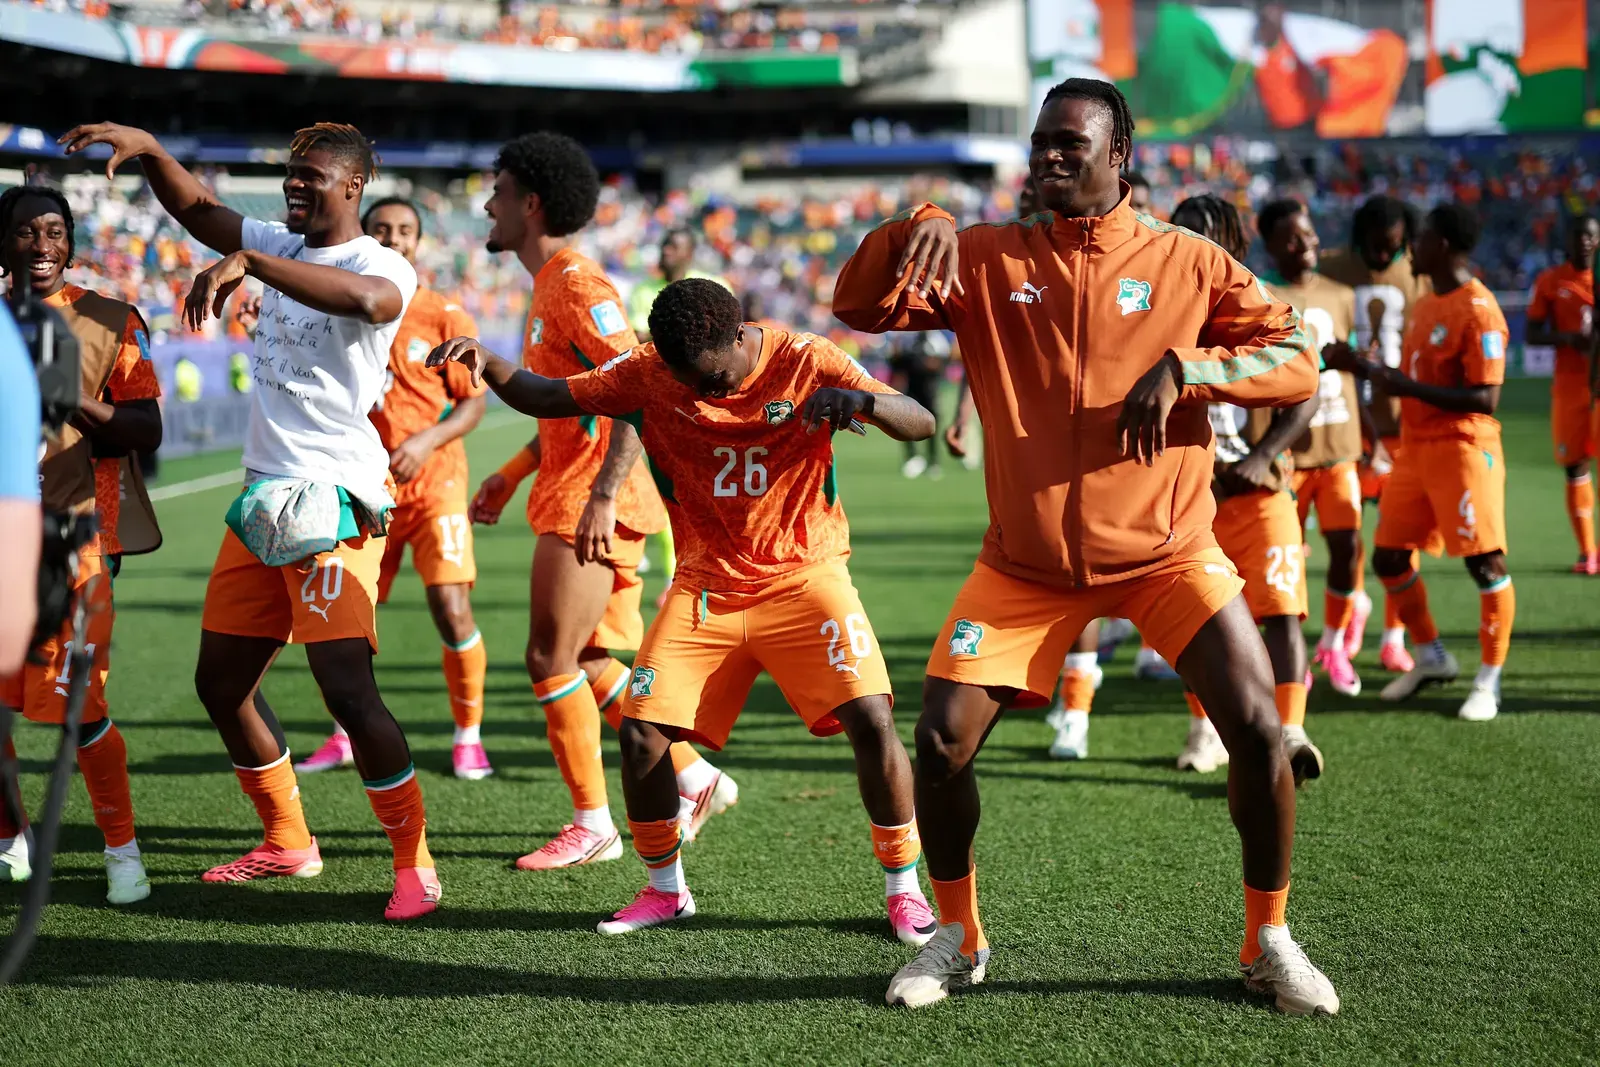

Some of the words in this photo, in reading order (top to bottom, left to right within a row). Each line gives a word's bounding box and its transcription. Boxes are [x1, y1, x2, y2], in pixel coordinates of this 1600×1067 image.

[1009, 291, 1034, 304] KING
[713, 446, 769, 497] 26
[437, 513, 467, 551] 17
[301, 556, 345, 604] 20
[1265, 544, 1301, 585] 25
[820, 613, 871, 666] 26
